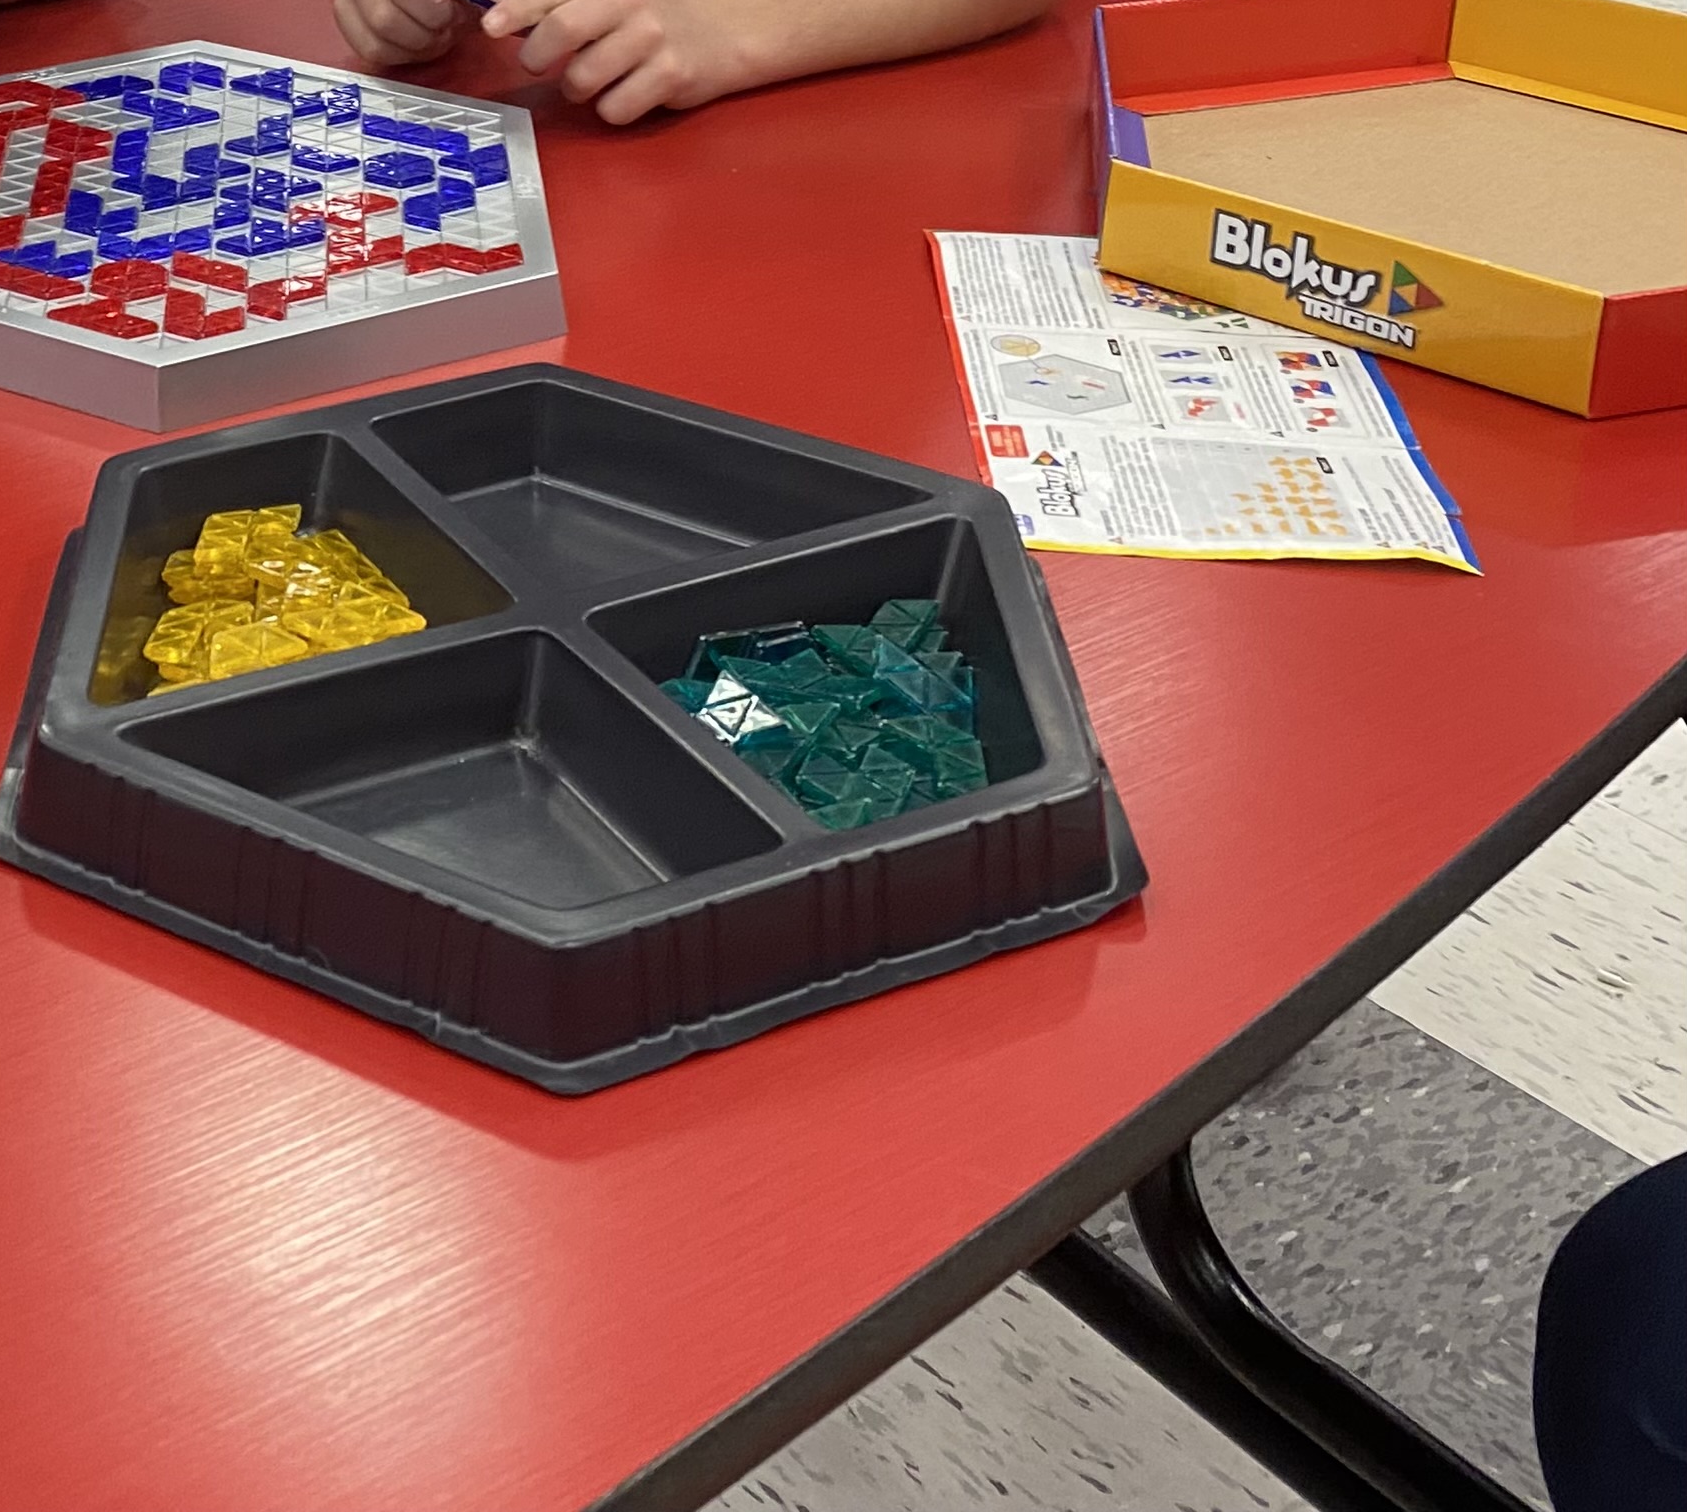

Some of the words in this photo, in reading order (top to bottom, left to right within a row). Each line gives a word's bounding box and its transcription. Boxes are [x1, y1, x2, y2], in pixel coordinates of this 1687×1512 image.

[1212, 210, 1379, 306] Blokus
[1297, 292, 1416, 348] TRIGON
[1036, 468, 1081, 518] Blokus
